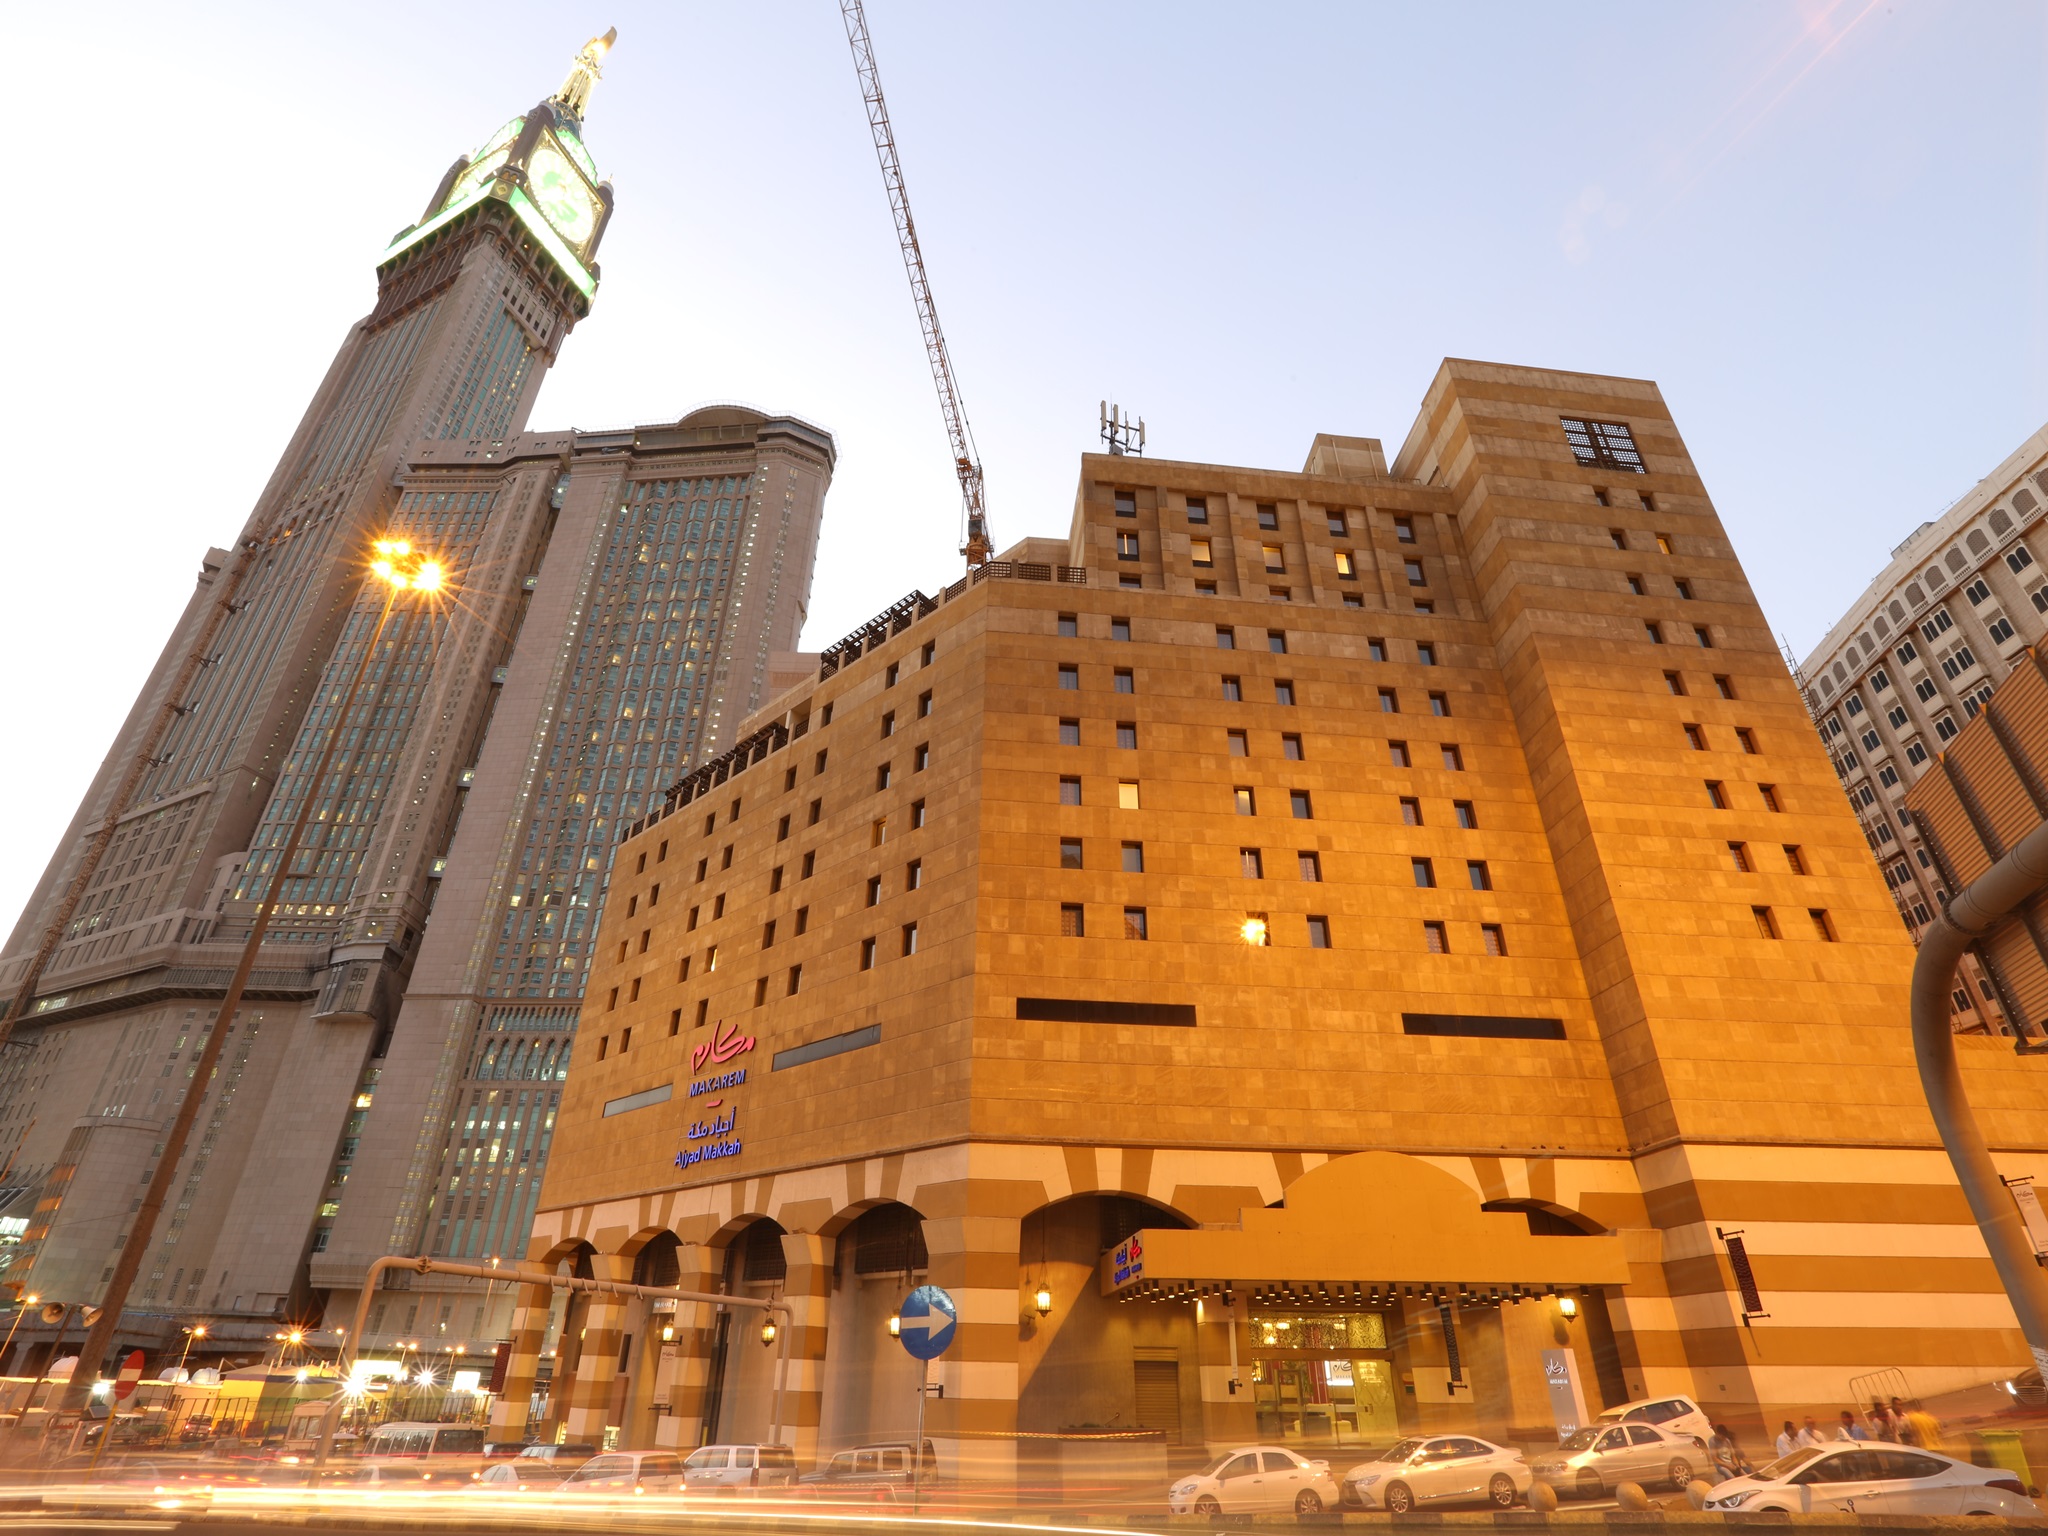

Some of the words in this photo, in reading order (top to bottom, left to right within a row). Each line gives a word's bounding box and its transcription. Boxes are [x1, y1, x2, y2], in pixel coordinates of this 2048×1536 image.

[690, 1019, 756, 1075] مكارم
[688, 1069, 747, 1098] MAKAREM
[687, 1121, 708, 1140] مكة
[674, 1146, 701, 1170] Ajyad
[703, 1138, 742, 1161] Makkah
